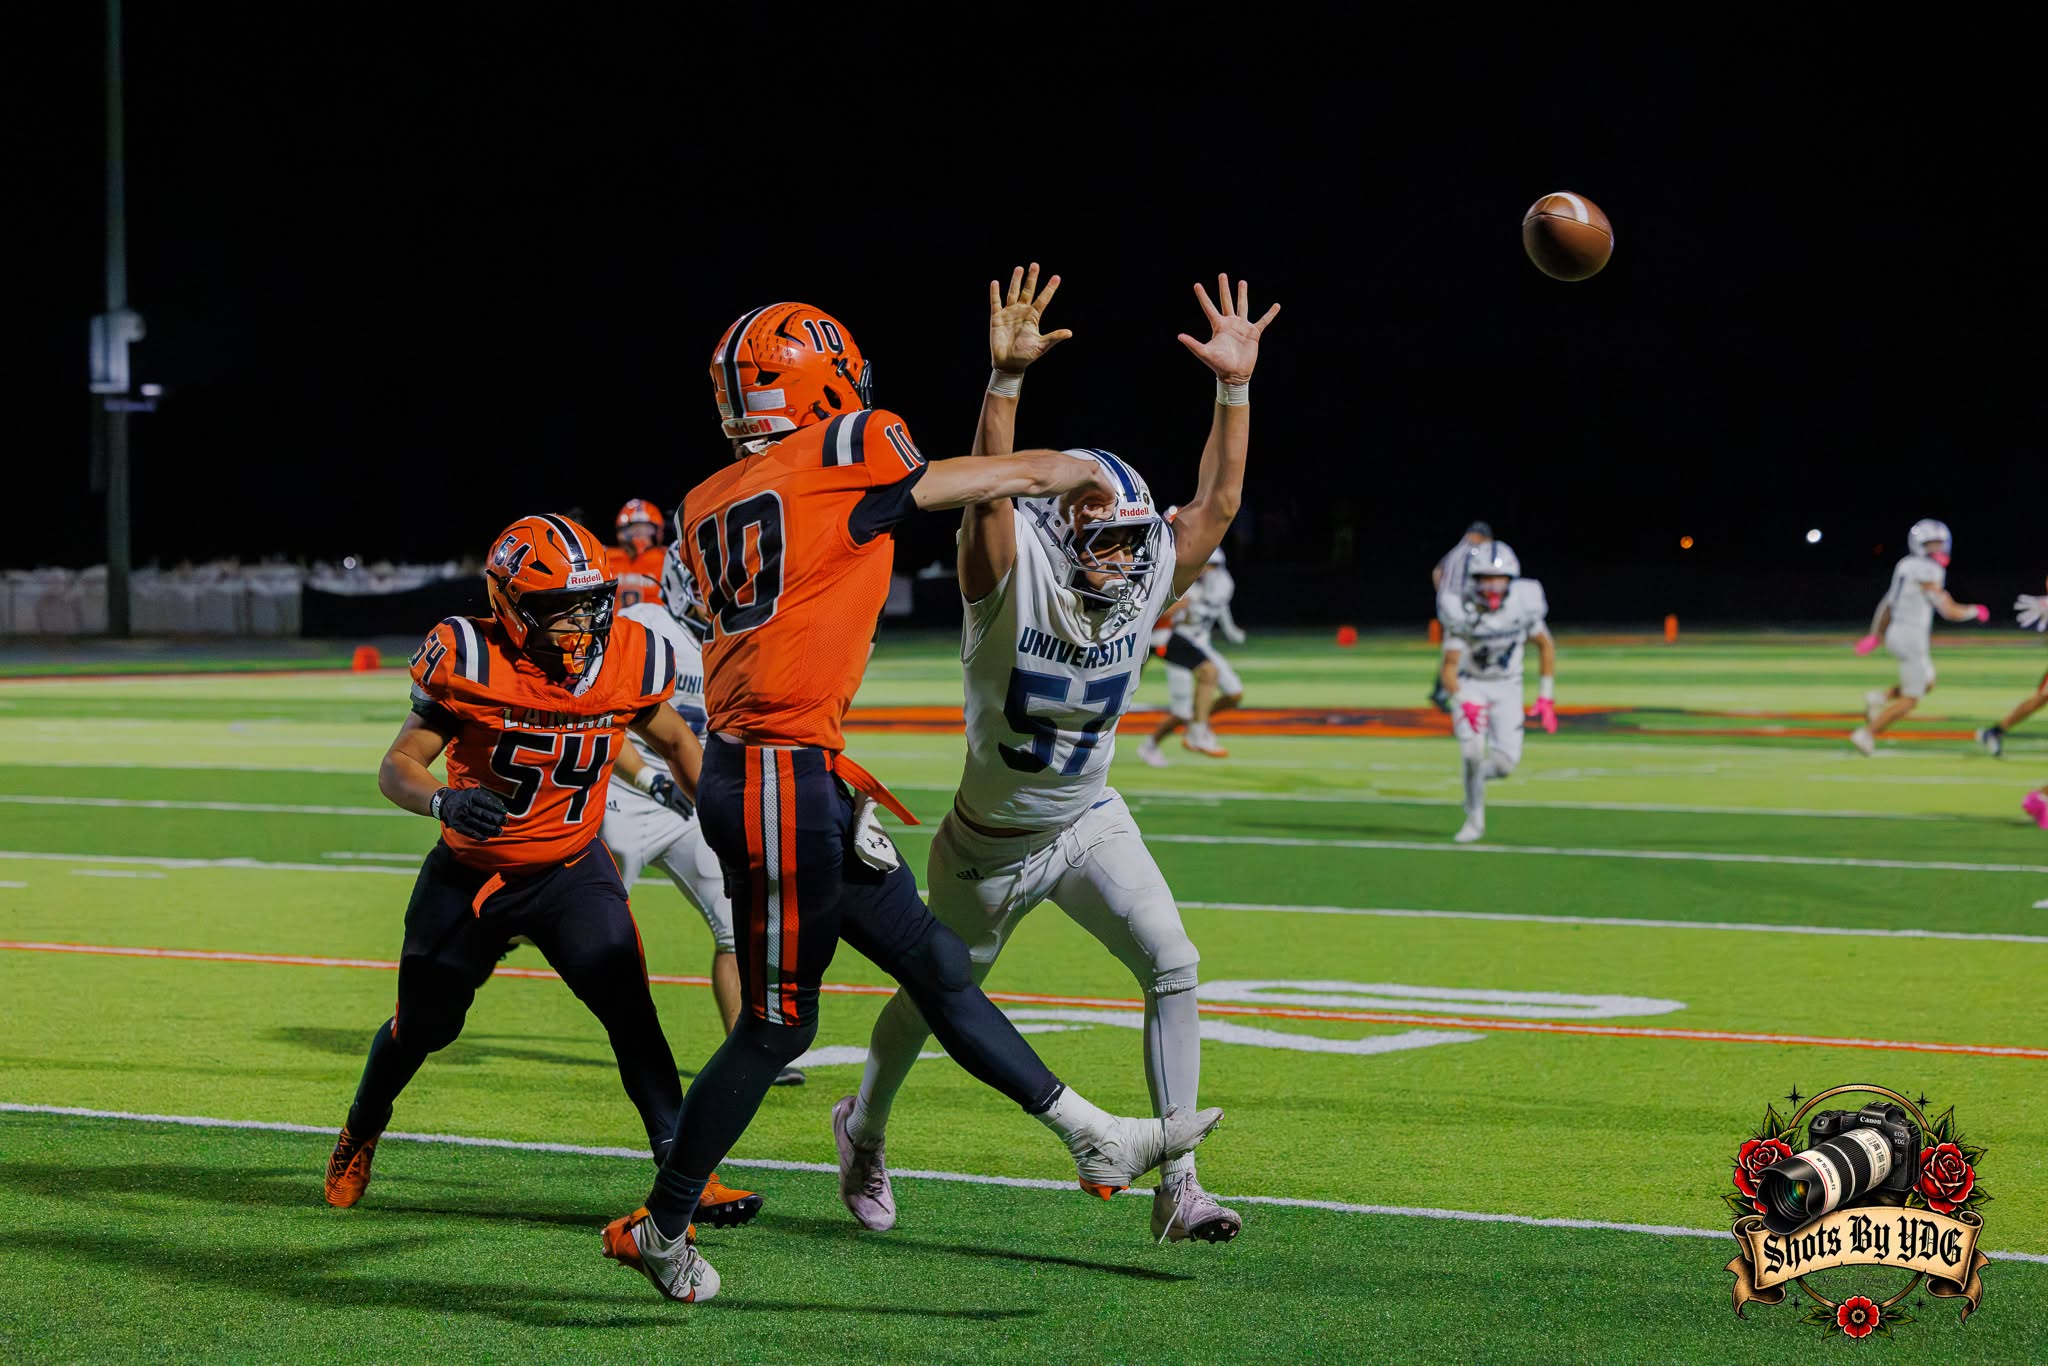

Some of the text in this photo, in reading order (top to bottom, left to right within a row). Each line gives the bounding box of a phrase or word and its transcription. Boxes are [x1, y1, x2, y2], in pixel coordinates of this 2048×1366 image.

[802, 319, 846, 354] 10
[1119, 506, 1150, 518] Riddell
[494, 533, 533, 577] 54
[696, 489, 786, 643] 10
[570, 572, 602, 586] Riddell
[407, 631, 448, 686] 54
[1017, 626, 1137, 670] UNIVERSITY
[998, 666, 1133, 776] 57
[489, 731, 614, 825] 54
